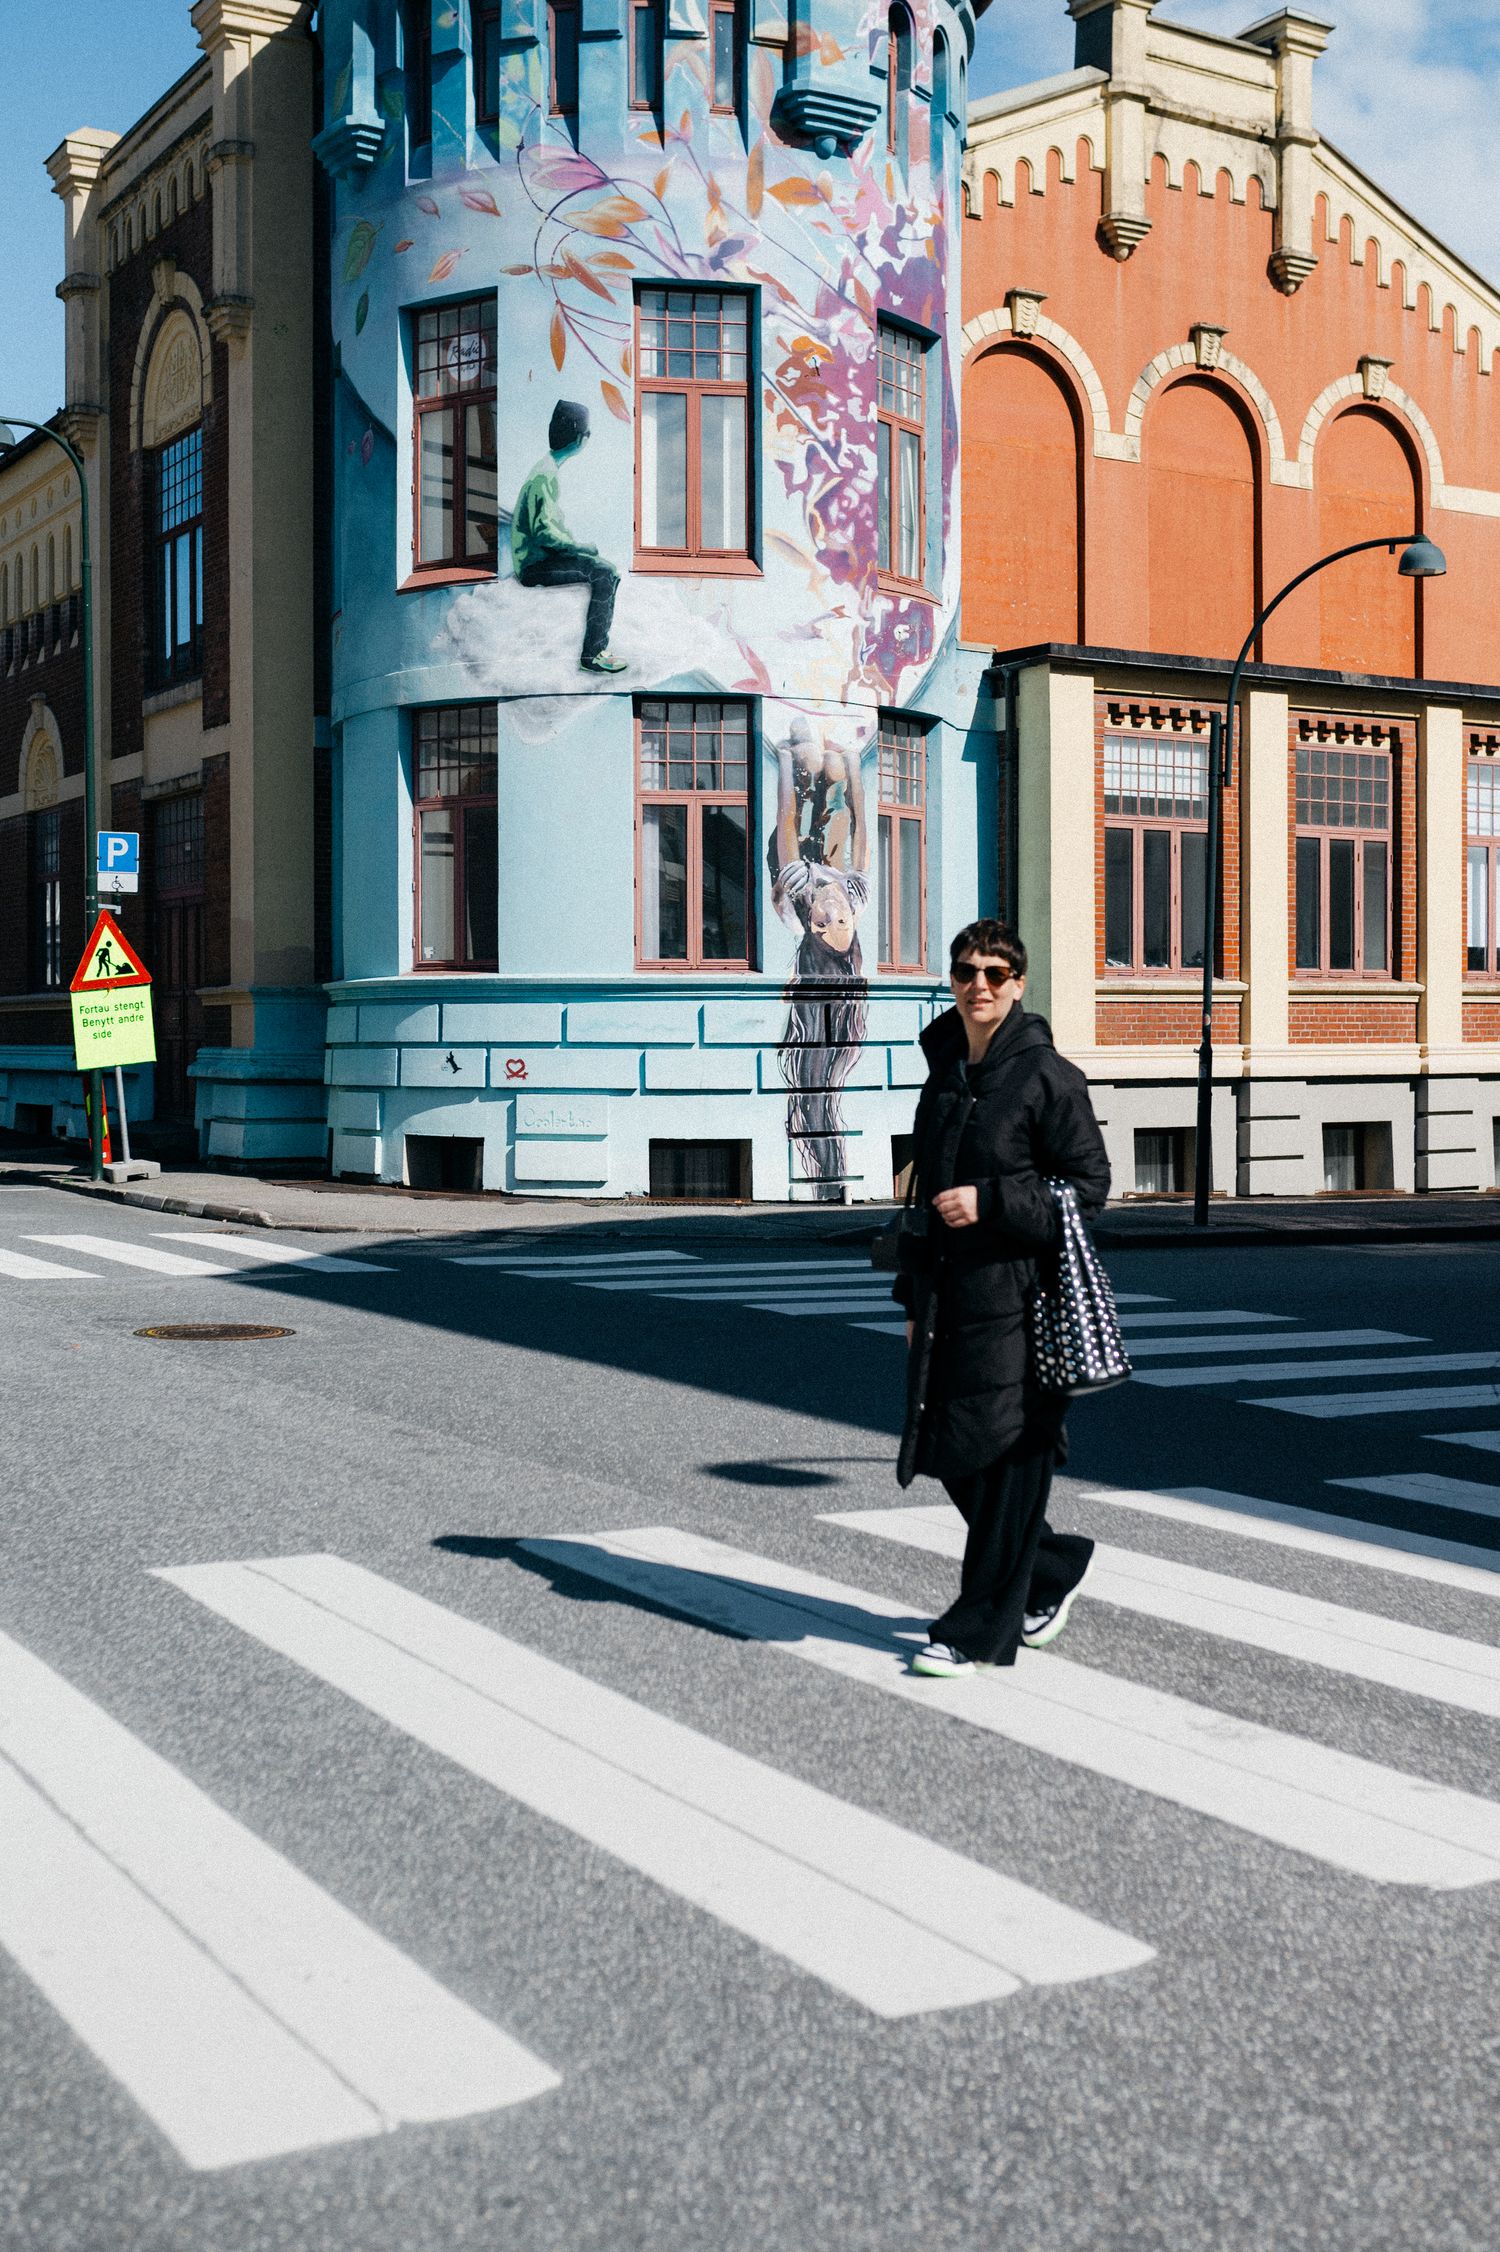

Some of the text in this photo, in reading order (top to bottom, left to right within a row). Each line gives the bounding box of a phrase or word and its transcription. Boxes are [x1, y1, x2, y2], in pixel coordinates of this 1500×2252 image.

[107, 837, 129, 868] P
[79, 1001, 144, 1014] Fortau stengt
[82, 1014, 144, 1027] Benytt andre
[92, 1030, 112, 1039] side
